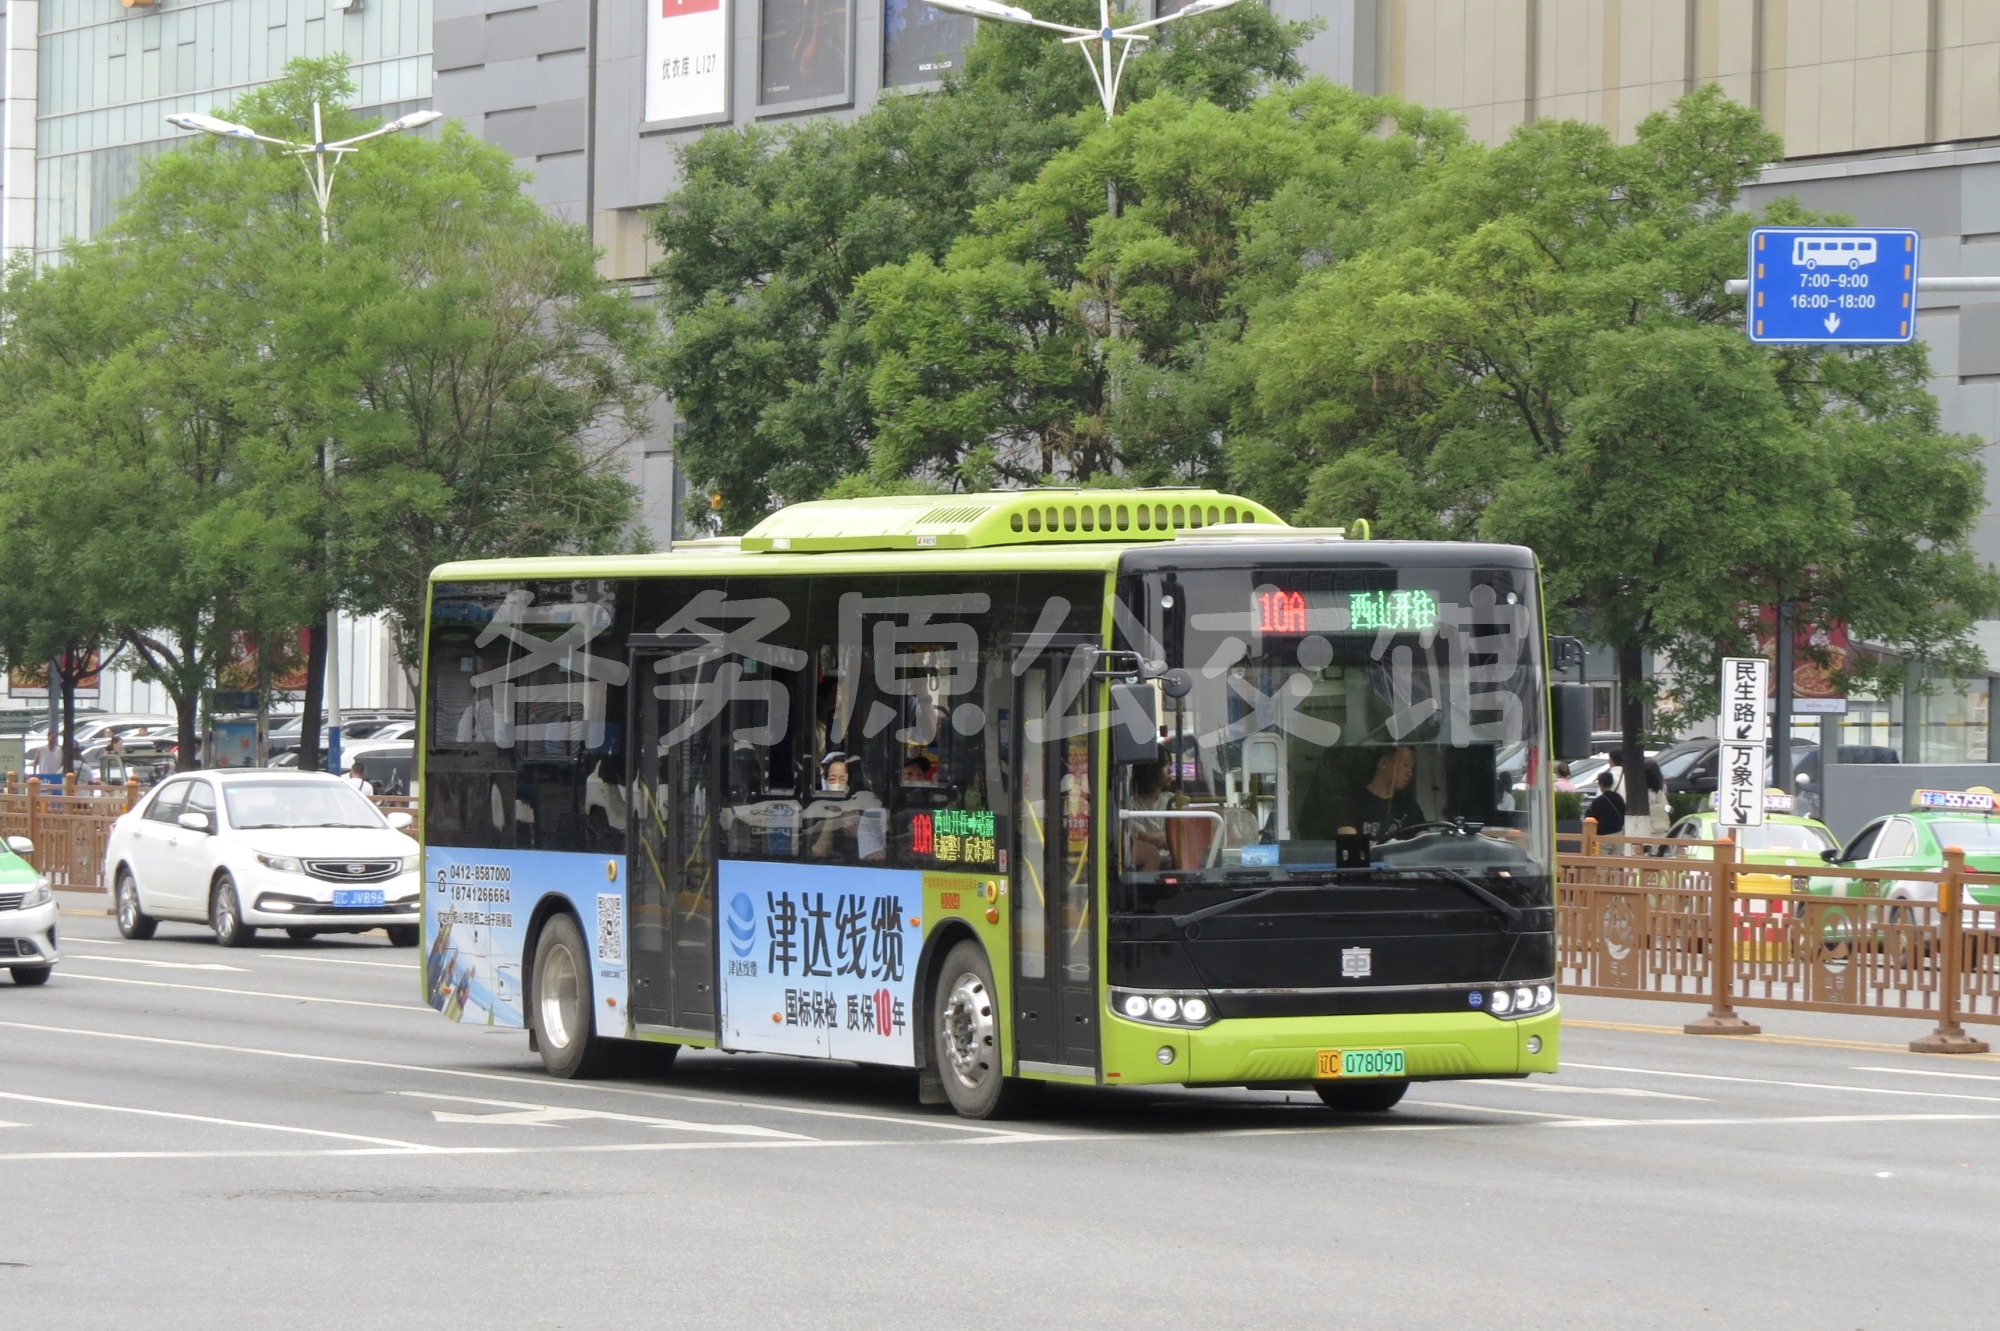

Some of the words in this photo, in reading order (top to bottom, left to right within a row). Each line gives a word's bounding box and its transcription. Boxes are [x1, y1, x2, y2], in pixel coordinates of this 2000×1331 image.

[662, 56, 690, 80] 优衣库
[1799, 273, 1869, 288] 7:00-9:00
[1790, 294, 1876, 309] 16:00-18:00
[1258, 590, 1307, 632] 10A
[1733, 661, 1757, 723] 民生路
[1730, 746, 1754, 809] 万象汇
[450, 864, 511, 882] 0412-8587000
[450, 887, 511, 903] 18741266664
[766, 890, 905, 982] 津达线缆
[785, 987, 838, 1030] 国标保检
[846, 987, 906, 1038] 质保10年
